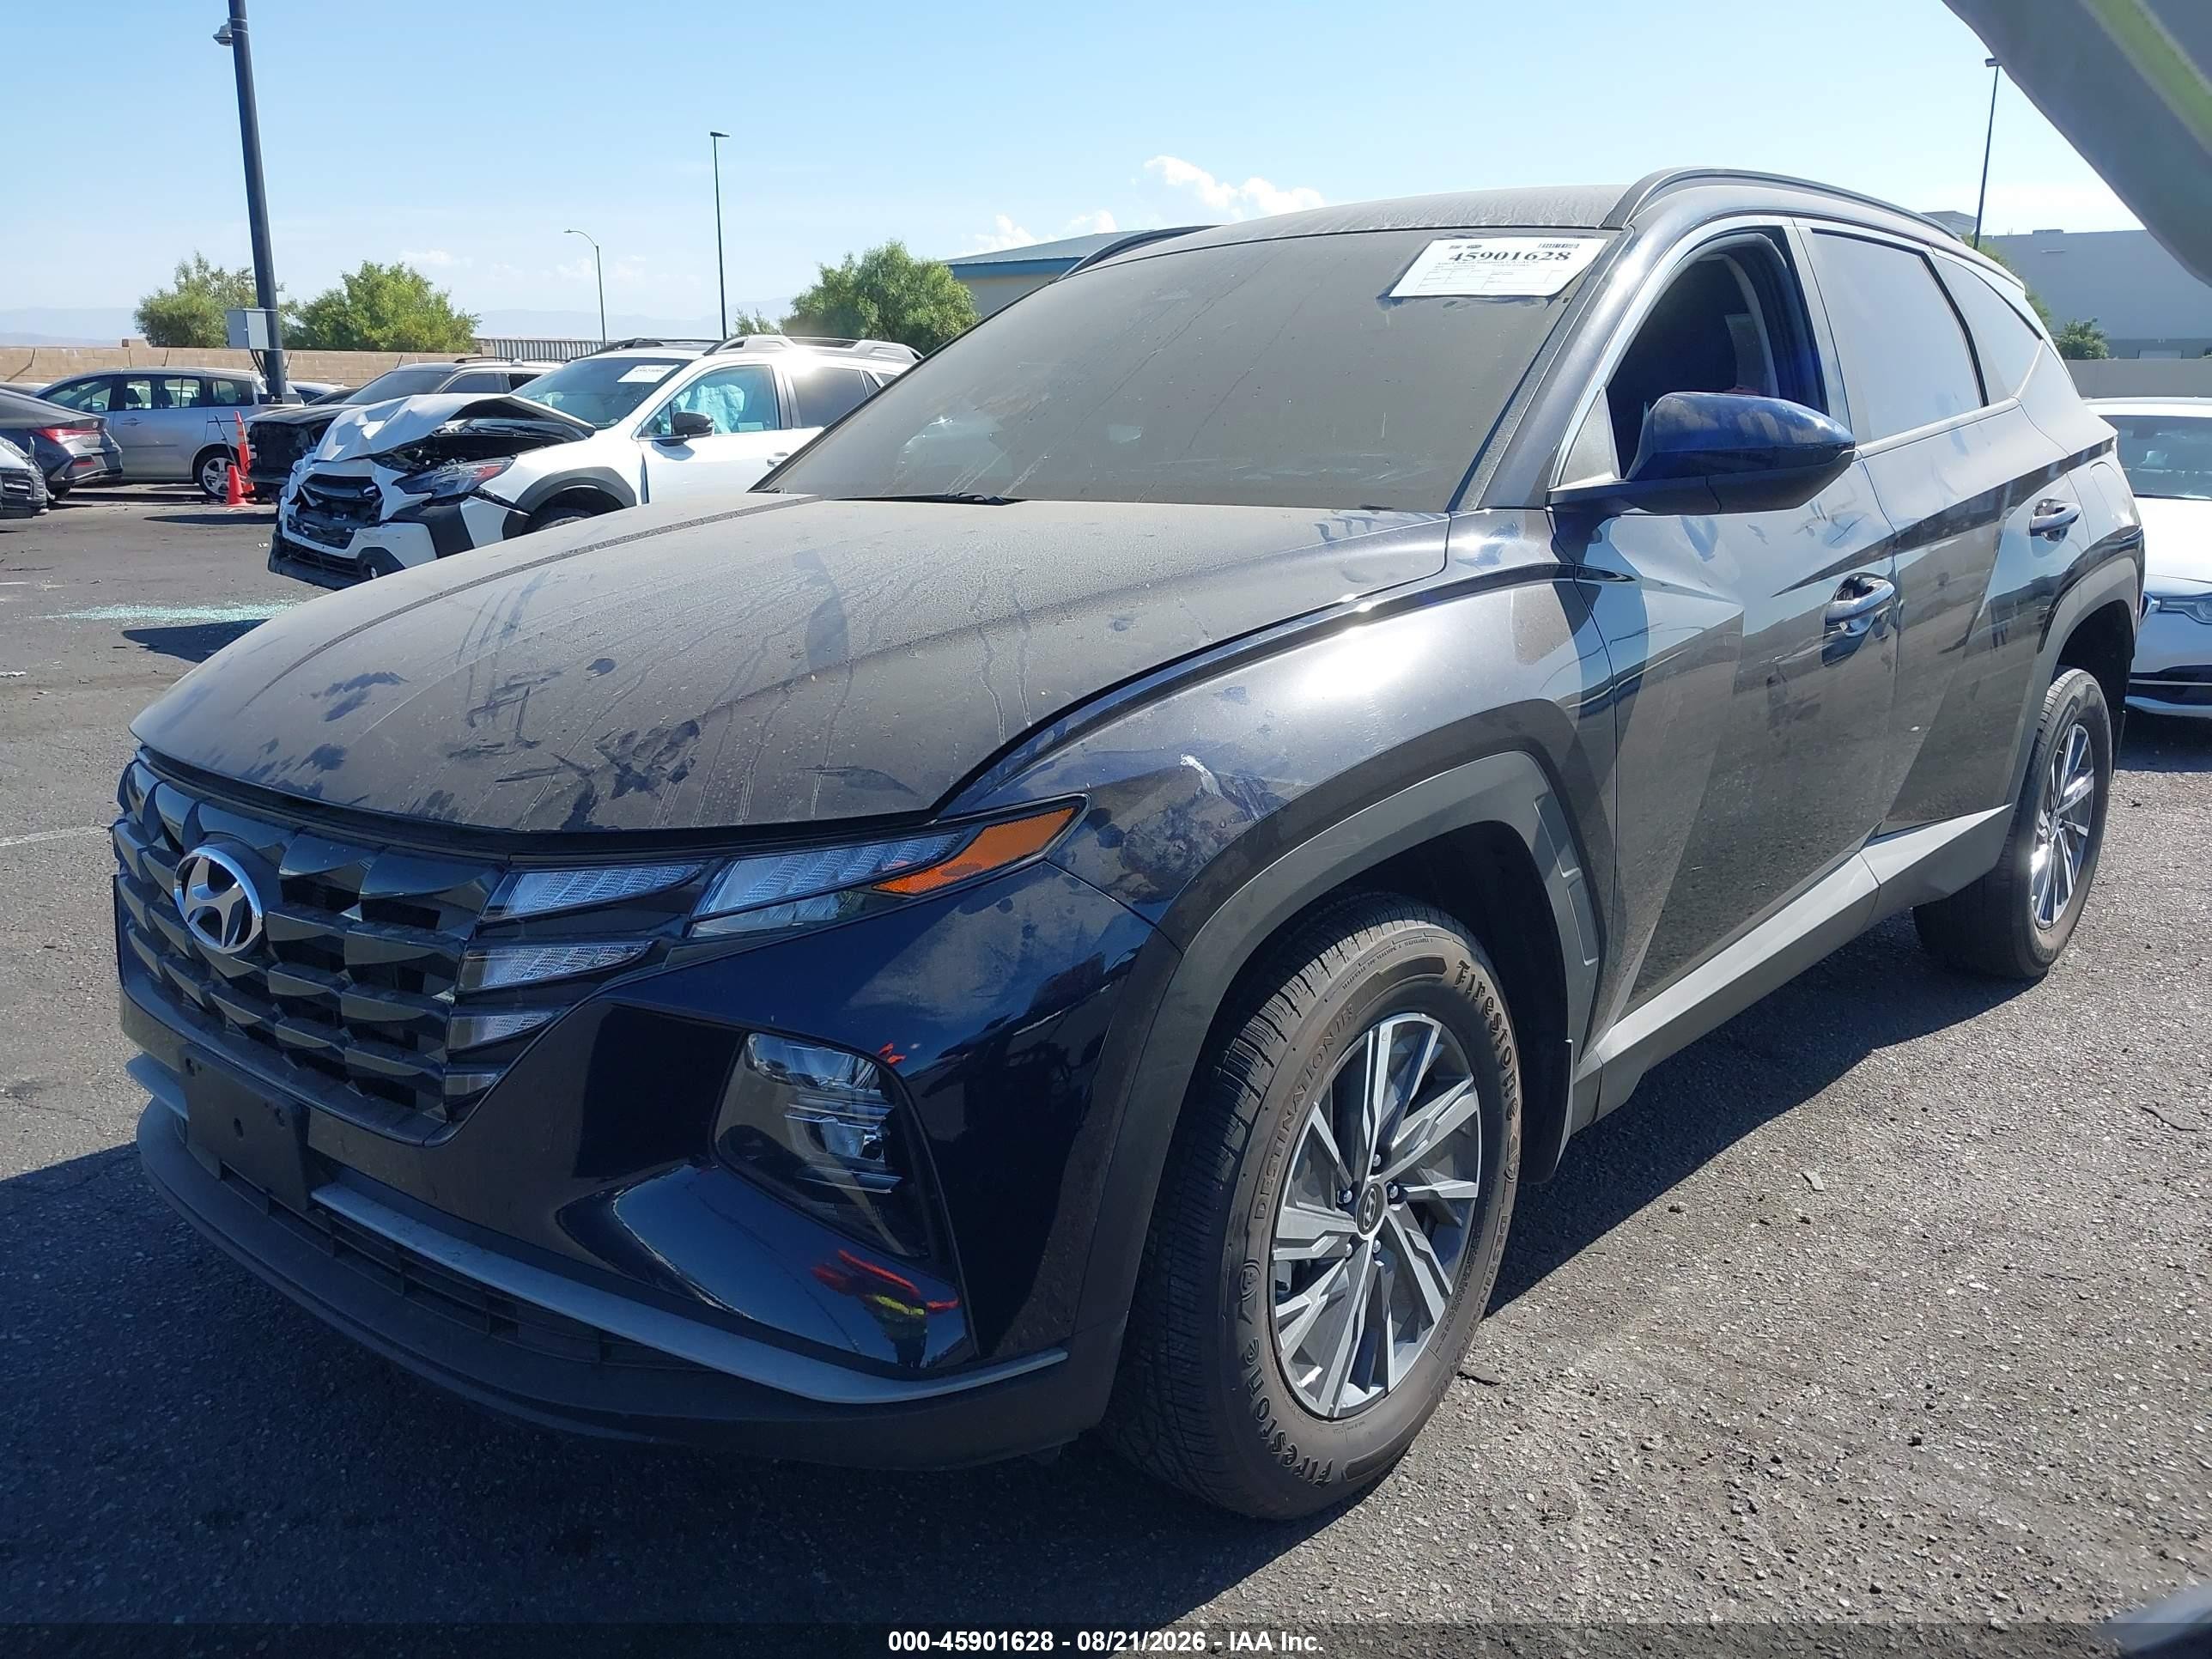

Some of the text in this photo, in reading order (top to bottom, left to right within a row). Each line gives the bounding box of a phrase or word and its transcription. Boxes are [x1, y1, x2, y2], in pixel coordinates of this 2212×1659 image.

[1449, 251, 1570, 261] 45901628
[1455, 959, 1519, 1121] Firestone
[1254, 1034, 1335, 1219] DESTINATION
[1244, 1337, 1334, 1489] Firestone
